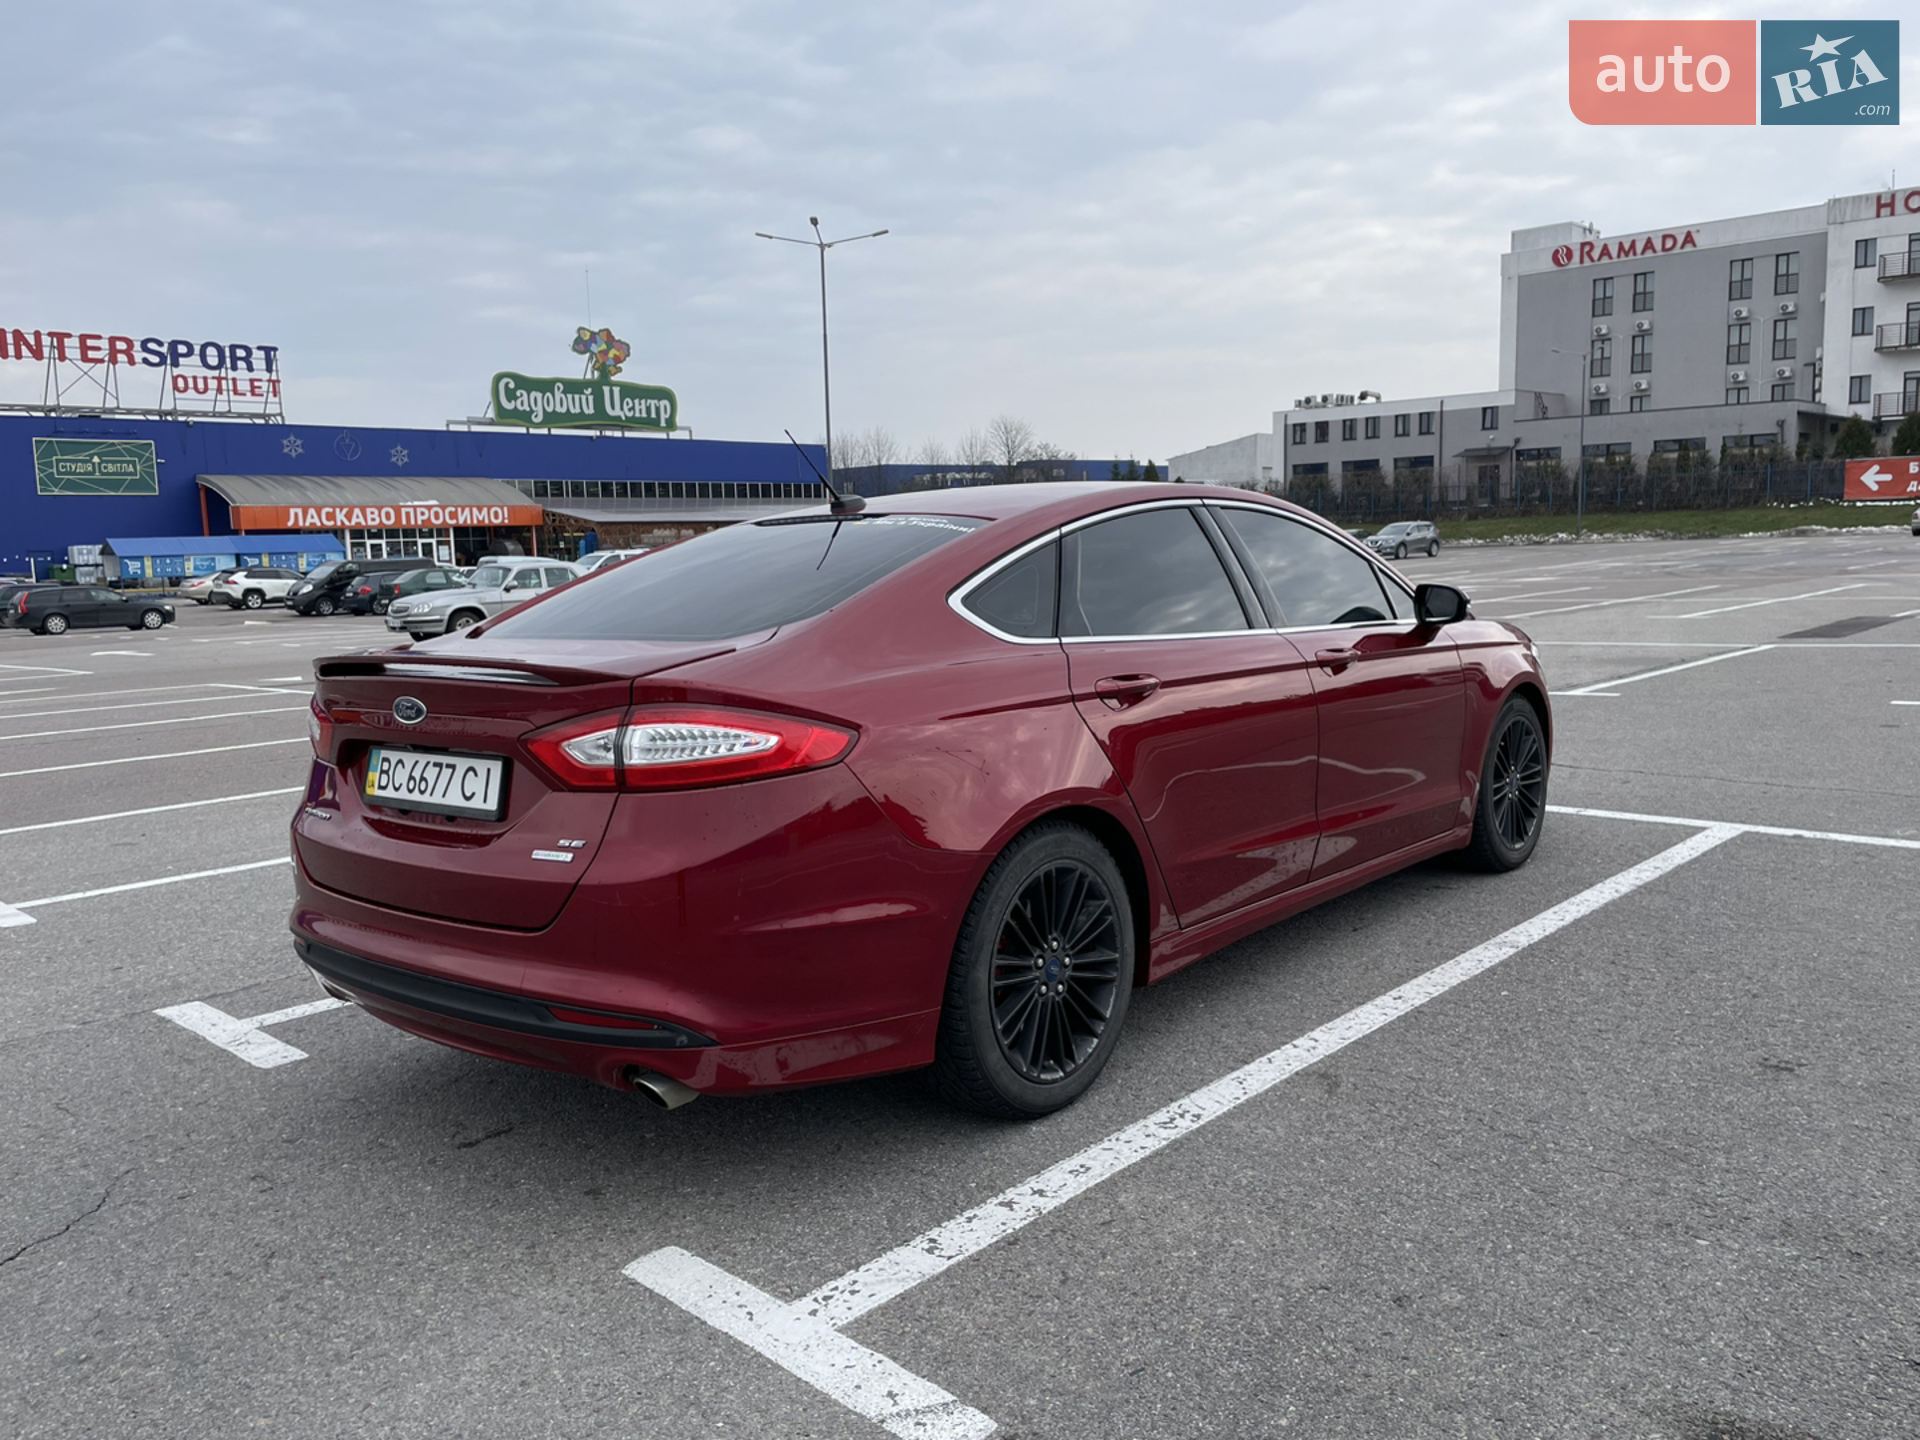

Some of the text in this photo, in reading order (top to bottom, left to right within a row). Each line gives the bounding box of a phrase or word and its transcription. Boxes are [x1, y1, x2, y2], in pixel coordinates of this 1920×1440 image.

[1579, 229, 1698, 265] RAMADA
[0, 327, 279, 373] INTERSPORT
[172, 374, 281, 397] OUTLET
[498, 377, 672, 427] Садовий Центр
[58, 462, 135, 474] СТУДІЯ СВІТЛА
[287, 506, 509, 527] ЛАСКАВО ПРОСИМО!
